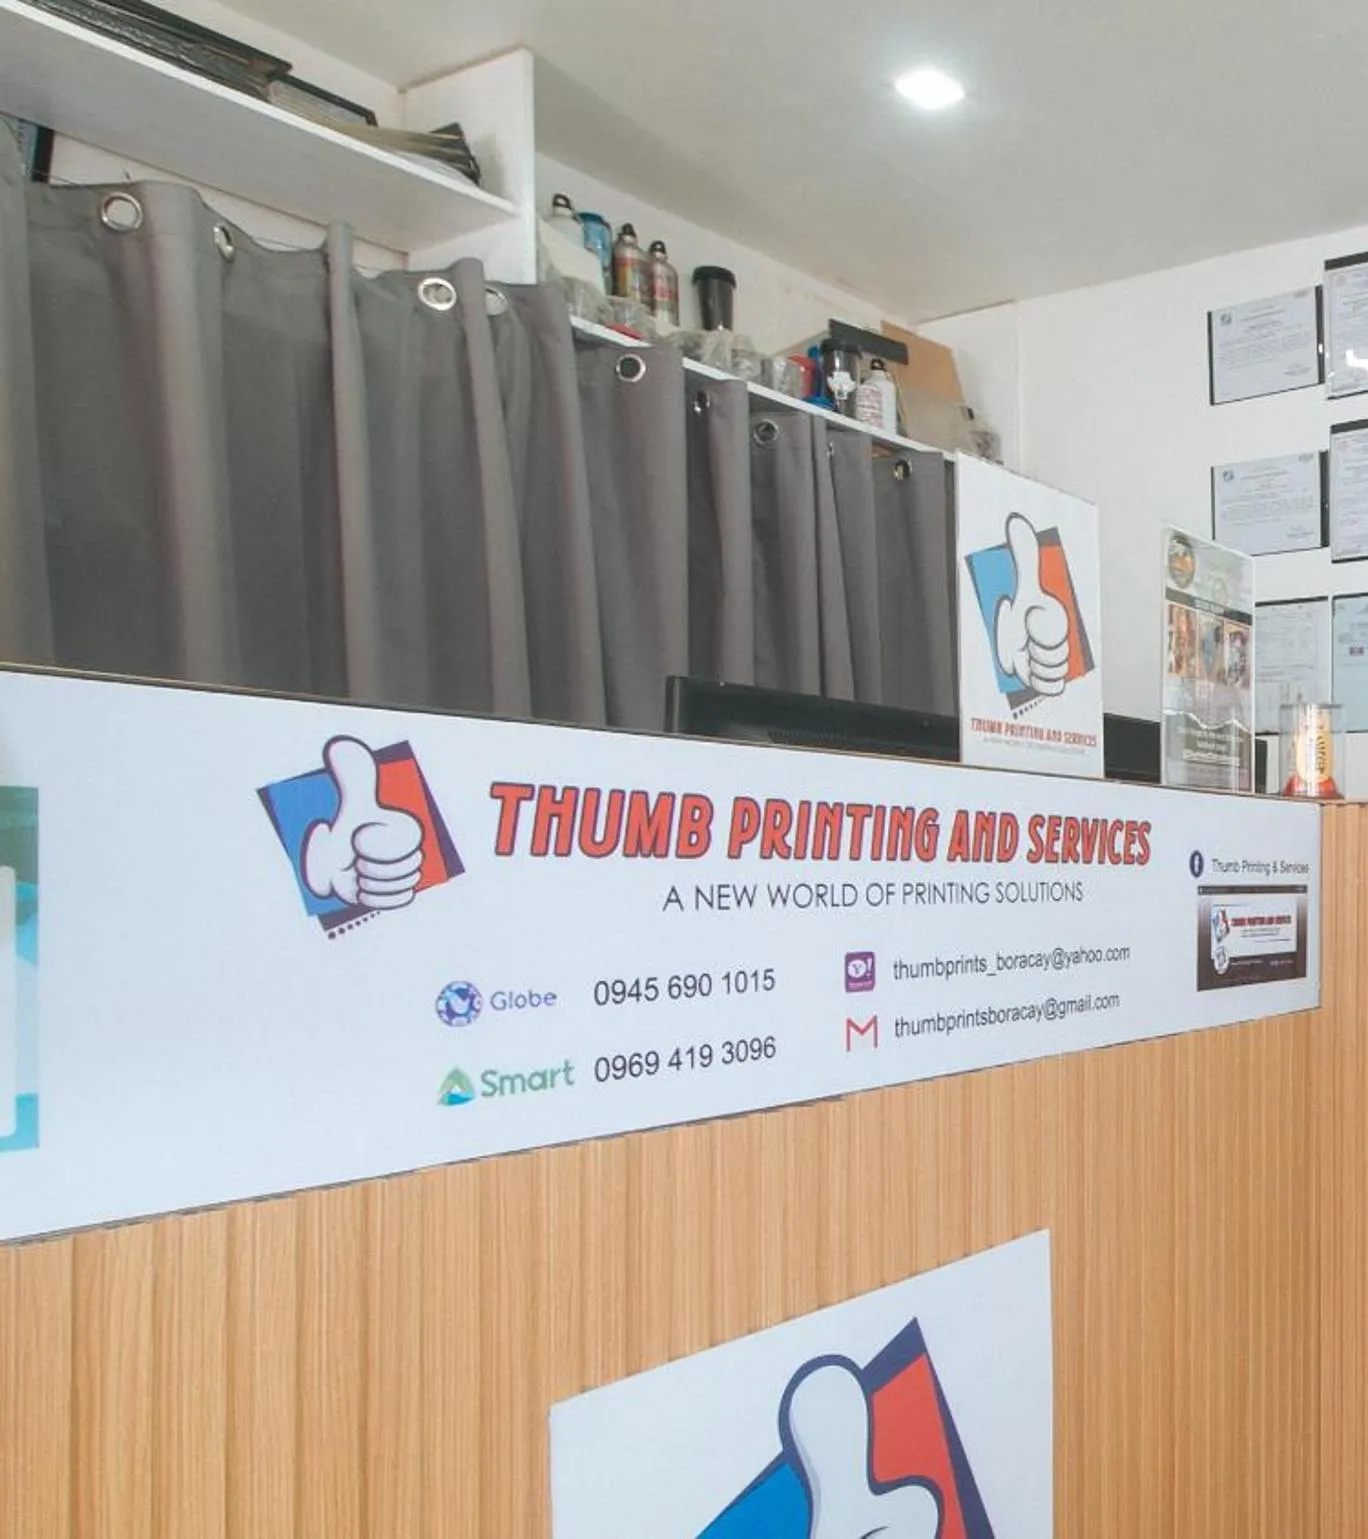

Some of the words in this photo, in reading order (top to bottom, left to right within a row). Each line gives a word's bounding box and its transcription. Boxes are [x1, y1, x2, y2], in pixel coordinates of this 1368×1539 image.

[490, 781, 714, 860] THUMB
[727, 795, 940, 863] PRINTING
[946, 809, 1020, 863] AND
[1026, 814, 1152, 866] SERVICES
[1211, 858, 1240, 874] Thumb
[1242, 860, 1270, 876] Printing
[1272, 861, 1278, 874] &
[1280, 860, 1309, 874] Services
[662, 885, 684, 912] A
[694, 884, 758, 911] NEW
[767, 881, 858, 910] WORLD
[865, 881, 898, 906] OF
[902, 881, 991, 907] PRINTING
[996, 880, 1083, 903] SOLUTIONS
[893, 947, 1131, 981] thumbprints_boracay@yahoo.com
[490, 989, 558, 1011] Globe
[594, 976, 660, 1006] 0945
[667, 973, 713, 1000] 690
[722, 968, 776, 995] 1015
[894, 994, 1120, 1038] thumbprintsboracay@gmail.com
[594, 1051, 660, 1082] 0969
[668, 1043, 713, 1072] 419
[722, 1035, 776, 1065] 3096
[480, 1060, 576, 1097] Smart
